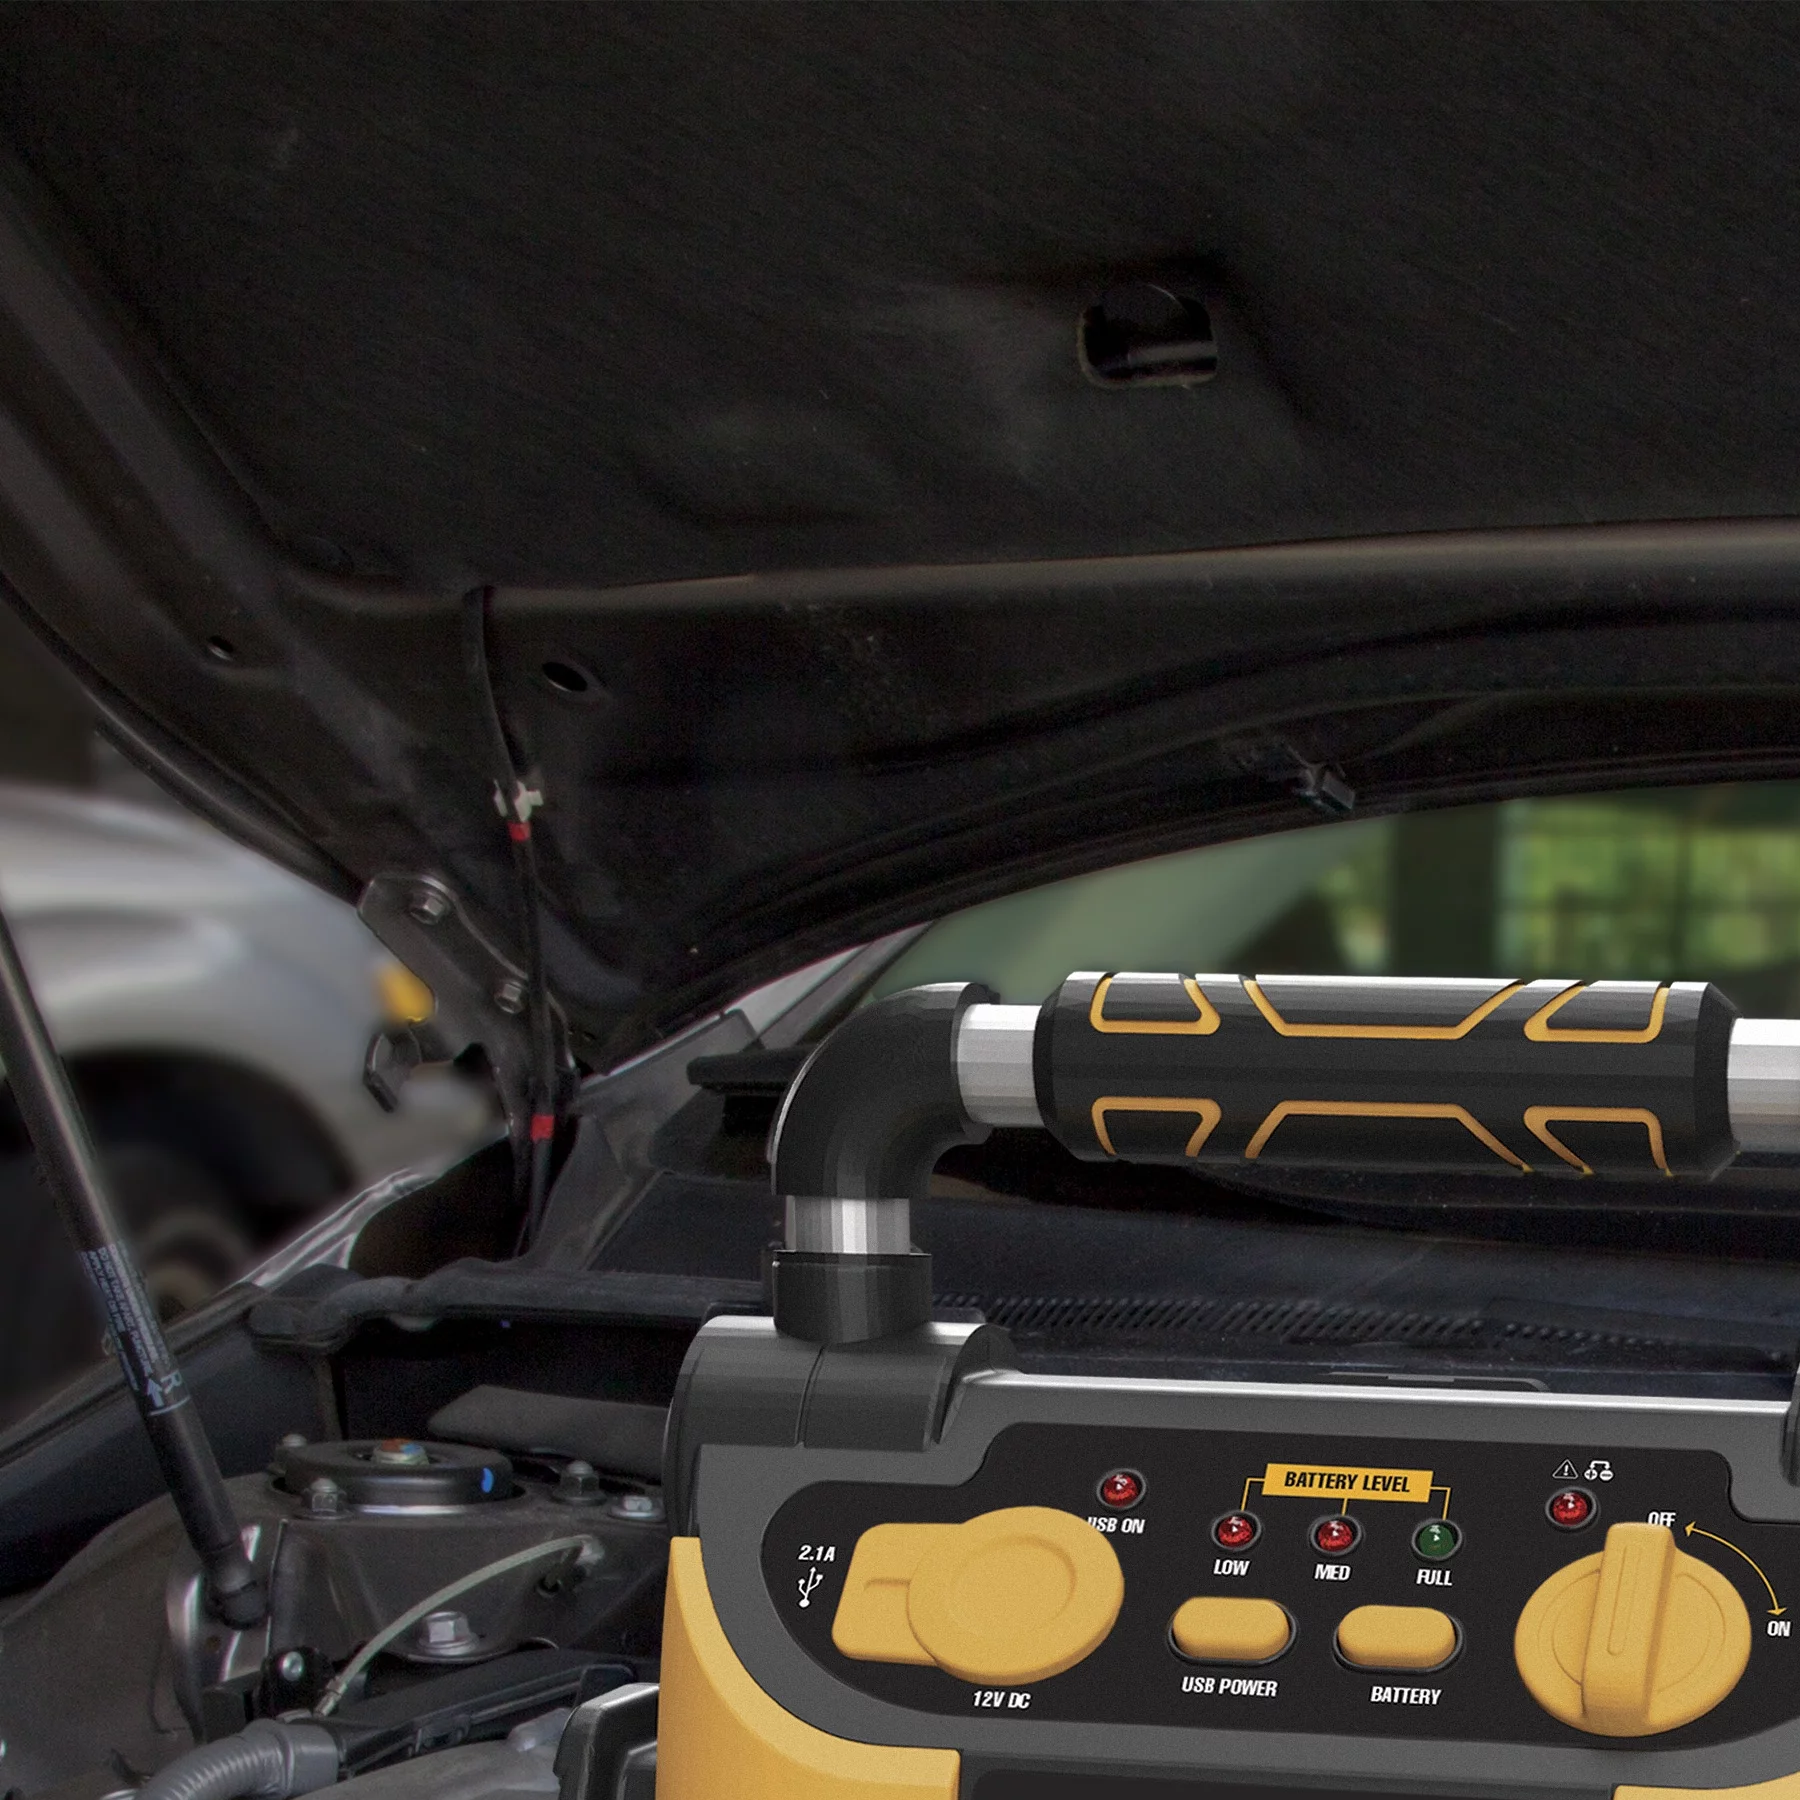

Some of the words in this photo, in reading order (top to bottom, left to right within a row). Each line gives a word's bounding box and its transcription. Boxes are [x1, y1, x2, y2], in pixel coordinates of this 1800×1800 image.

[1284, 1470, 1357, 1490] BATTERY
[1362, 1474, 1411, 1494] LEVEL
[1121, 1518, 1145, 1534] ON
[1648, 1511, 1676, 1527] OFF
[798, 1545, 836, 1563] 2.1A
[1213, 1559, 1250, 1577] LOW
[1314, 1564, 1351, 1581] MED
[1416, 1568, 1453, 1587] FULL
[1767, 1620, 1791, 1637] ON
[1182, 1676, 1216, 1695] USB
[1218, 1678, 1278, 1698] POWER
[1370, 1686, 1441, 1706] BATTERY
[973, 1690, 1005, 1708] 12V
[1007, 1692, 1031, 1709] DC
